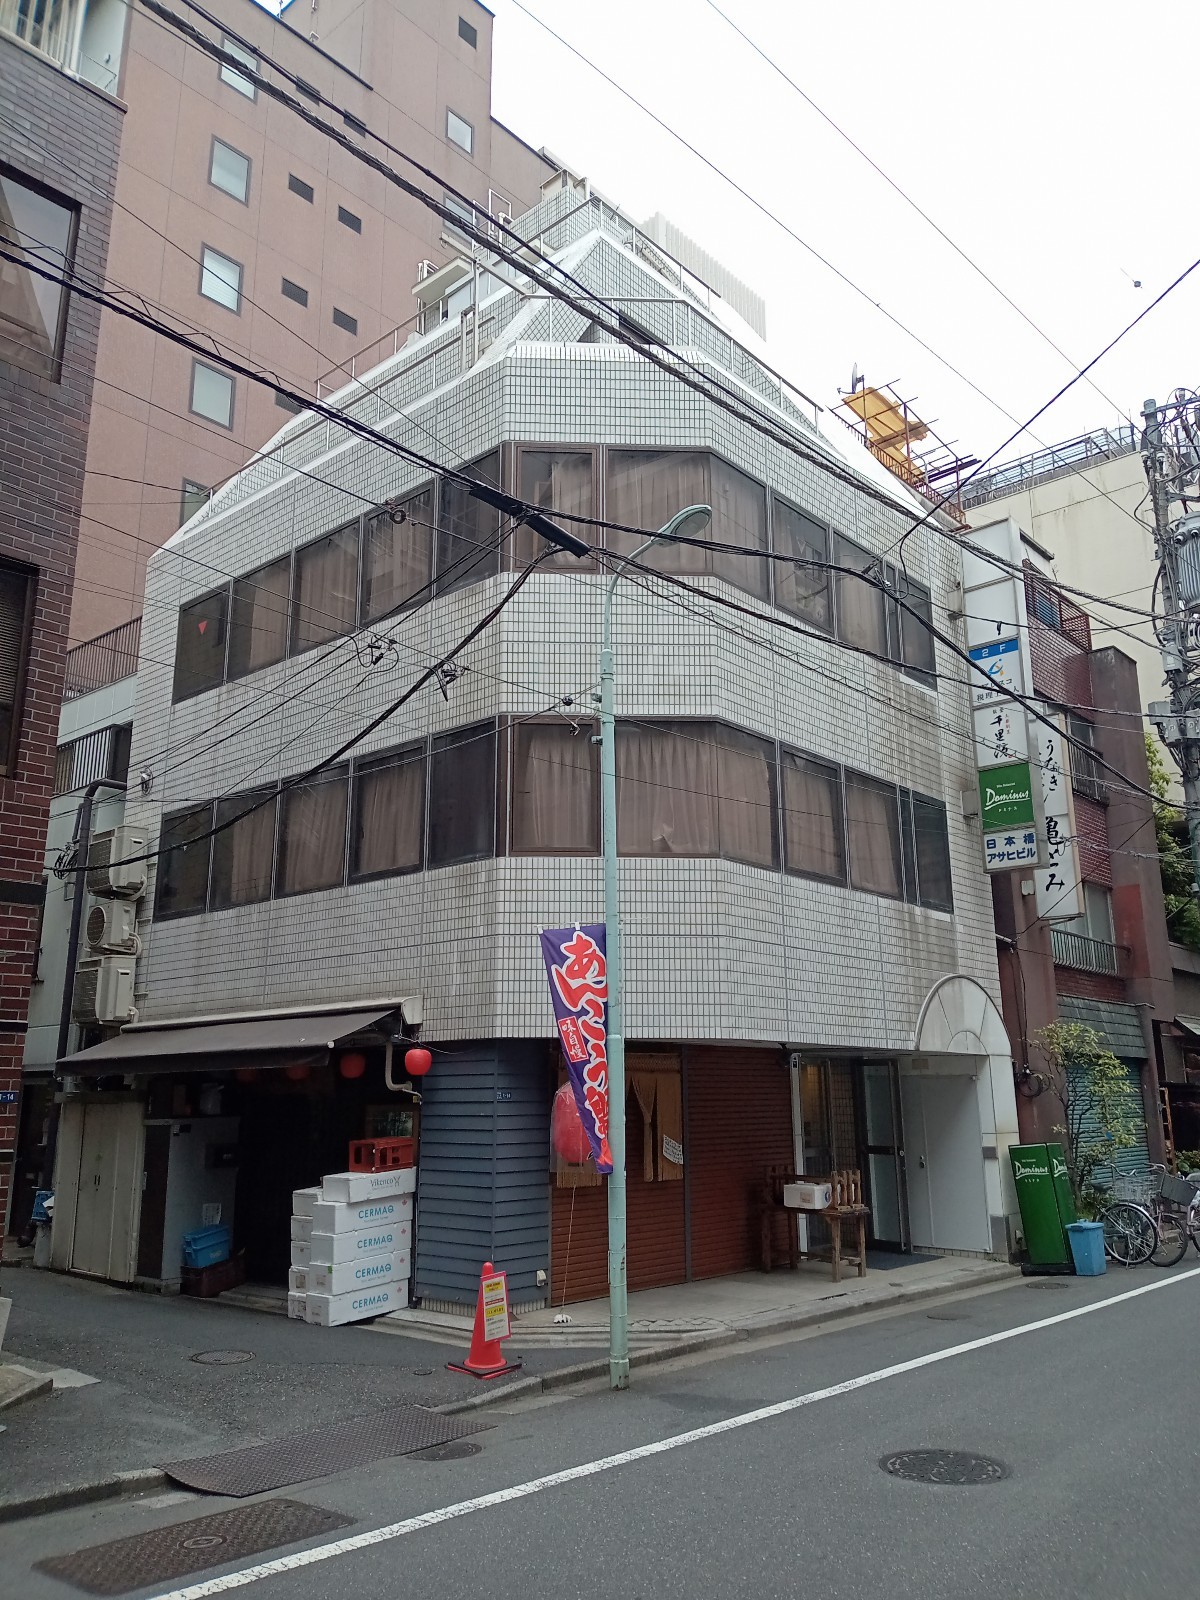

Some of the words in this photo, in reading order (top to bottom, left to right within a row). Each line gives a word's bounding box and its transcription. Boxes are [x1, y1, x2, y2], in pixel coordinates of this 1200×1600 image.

[984, 788, 1030, 806] Dominus
[986, 833, 1034, 849] 日本橋
[987, 847, 1036, 864] アサヒビル
[562, 1019, 587, 1059] 味自慢
[358, 1205, 394, 1219] CERMAQ
[357, 1234, 393, 1249] CERMAQ
[355, 1263, 392, 1279] CERMAQ
[352, 1293, 389, 1310] CERMAQ
